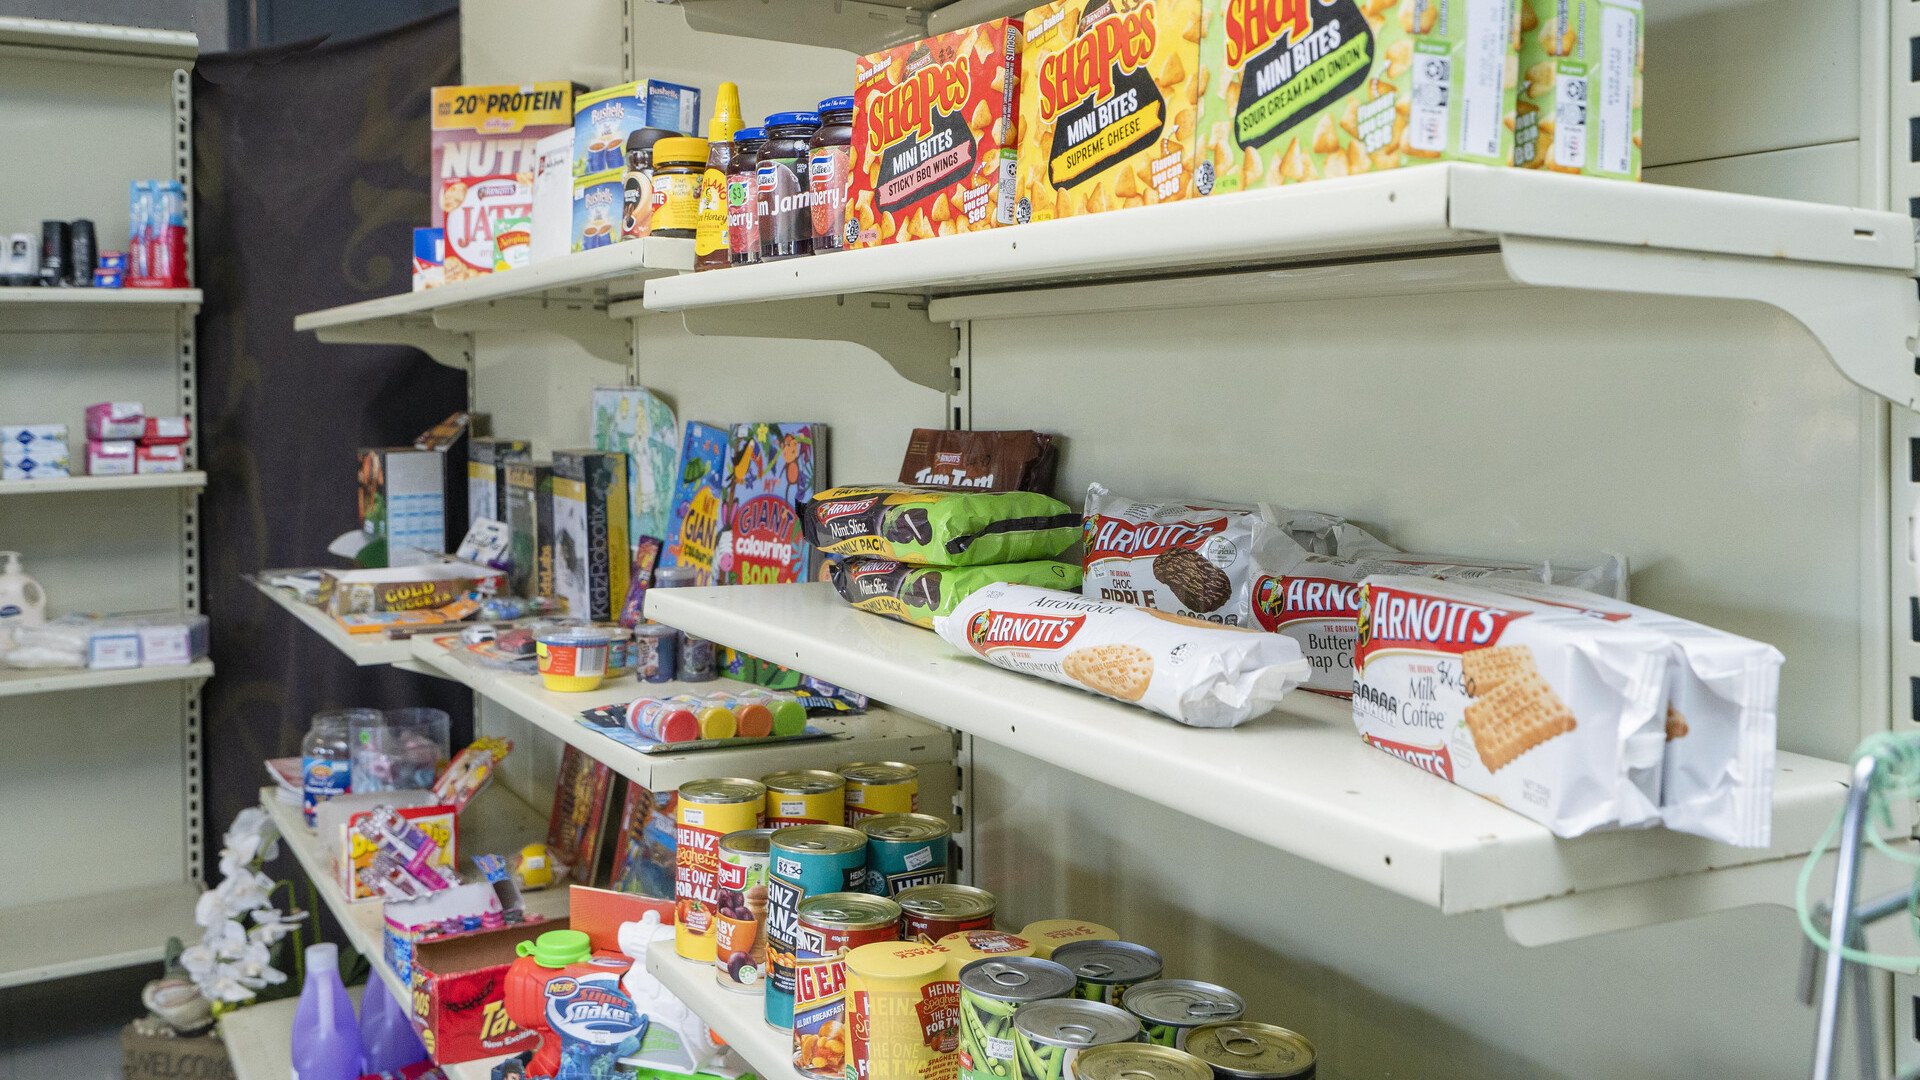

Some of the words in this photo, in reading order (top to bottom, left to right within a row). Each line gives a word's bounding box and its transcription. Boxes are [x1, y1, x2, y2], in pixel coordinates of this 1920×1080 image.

[1027, 24, 1043, 42] Oven
[1006, 28, 1016, 61] BISCUITS
[1256, 51, 1292, 97] MINI
[1293, 19, 1341, 72] BITES
[858, 69, 872, 83] Oven
[873, 56, 892, 73] Baked
[1242, 105, 1266, 131] SOUR
[1267, 85, 1301, 117] CREAM
[1304, 66, 1326, 95] AND
[1328, 46, 1361, 79] ONION
[486, 90, 563, 113] PROTEIN
[1067, 113, 1096, 147] MINI
[1100, 88, 1138, 130] BITES
[893, 150, 918, 176] MINI
[921, 129, 953, 163] BITES
[1066, 141, 1105, 169] SUPREME
[1107, 118, 1141, 147] CHEESE
[1152, 151, 1182, 174] Flavour
[889, 174, 914, 197] STICKY
[916, 167, 931, 183] BBQ
[933, 152, 958, 174] WINGS
[1153, 173, 1166, 188] you
[1167, 164, 1182, 179] can
[732, 189, 742, 200] $3
[963, 184, 988, 201] Flavour
[1159, 178, 1180, 199] see
[771, 190, 810, 217] Jam
[964, 201, 976, 213] you
[976, 196, 989, 207] can
[704, 213, 728, 226] Honey
[969, 209, 986, 224] see
[915, 467, 949, 484] Tim
[763, 478, 776, 494] MY
[827, 500, 874, 516] ARNOTT'S
[739, 500, 795, 542] GIANT
[830, 522, 849, 540] Mint
[848, 519, 868, 535] Slice
[832, 540, 858, 555] FAMILY
[859, 538, 886, 553] PACK
[1095, 520, 1214, 554] ARNOTT'S
[735, 535, 792, 566] colouring
[741, 561, 780, 585] BOOK
[385, 582, 435, 603] GOLD
[859, 580, 875, 596] Mint
[874, 578, 888, 594] Slice
[1112, 579, 1132, 589] CHOC
[863, 599, 882, 613] FAMILY
[883, 599, 903, 614] PACK
[1028, 596, 1123, 615] Arrowroot
[987, 615, 1075, 643] ARNOTT'S
[1324, 625, 1334, 633] THE
[1013, 658, 1072, 674] Arrowroot
[1302, 651, 1333, 673] nap
[1409, 677, 1436, 701] Milk
[1402, 702, 1445, 730] Coffee
[677, 828, 714, 852] HEINZ
[678, 867, 690, 882] THE
[691, 870, 714, 887] ONE
[778, 861, 803, 875] $2.50
[676, 882, 694, 899] FOR
[695, 886, 718, 905] ALL
[780, 933, 793, 945] ALL
[548, 983, 575, 994] NERF
[579, 988, 630, 1008] Super
[562, 1003, 634, 1023] Soaker
[812, 1004, 845, 1022] BREAKFAST
[931, 1009, 945, 1023] THE
[926, 1019, 946, 1036] FOR
